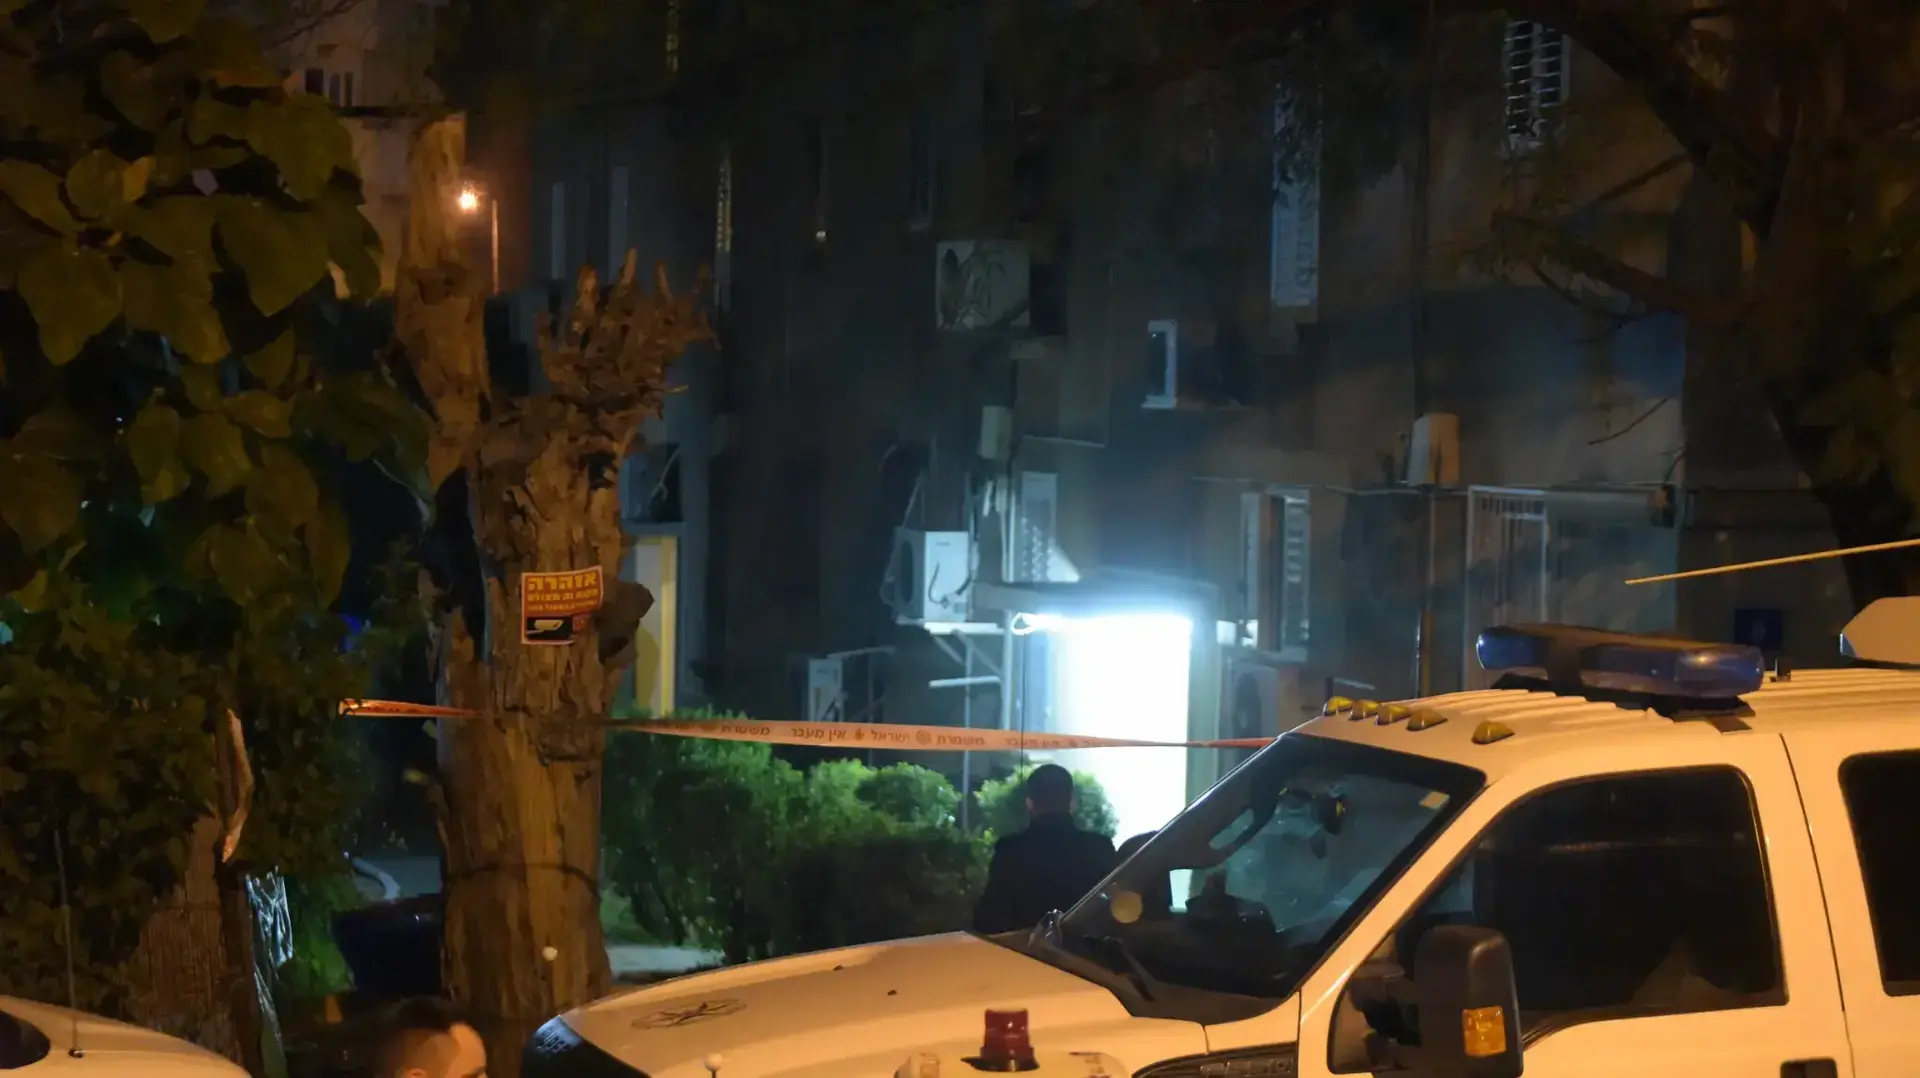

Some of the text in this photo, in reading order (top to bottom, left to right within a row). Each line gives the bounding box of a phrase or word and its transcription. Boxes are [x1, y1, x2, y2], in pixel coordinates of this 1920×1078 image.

[527, 572, 596, 590] אזהרה
[790, 727, 825, 739] מעבר
[829, 728, 847, 742] אין
[870, 729, 910, 742] ישראל
